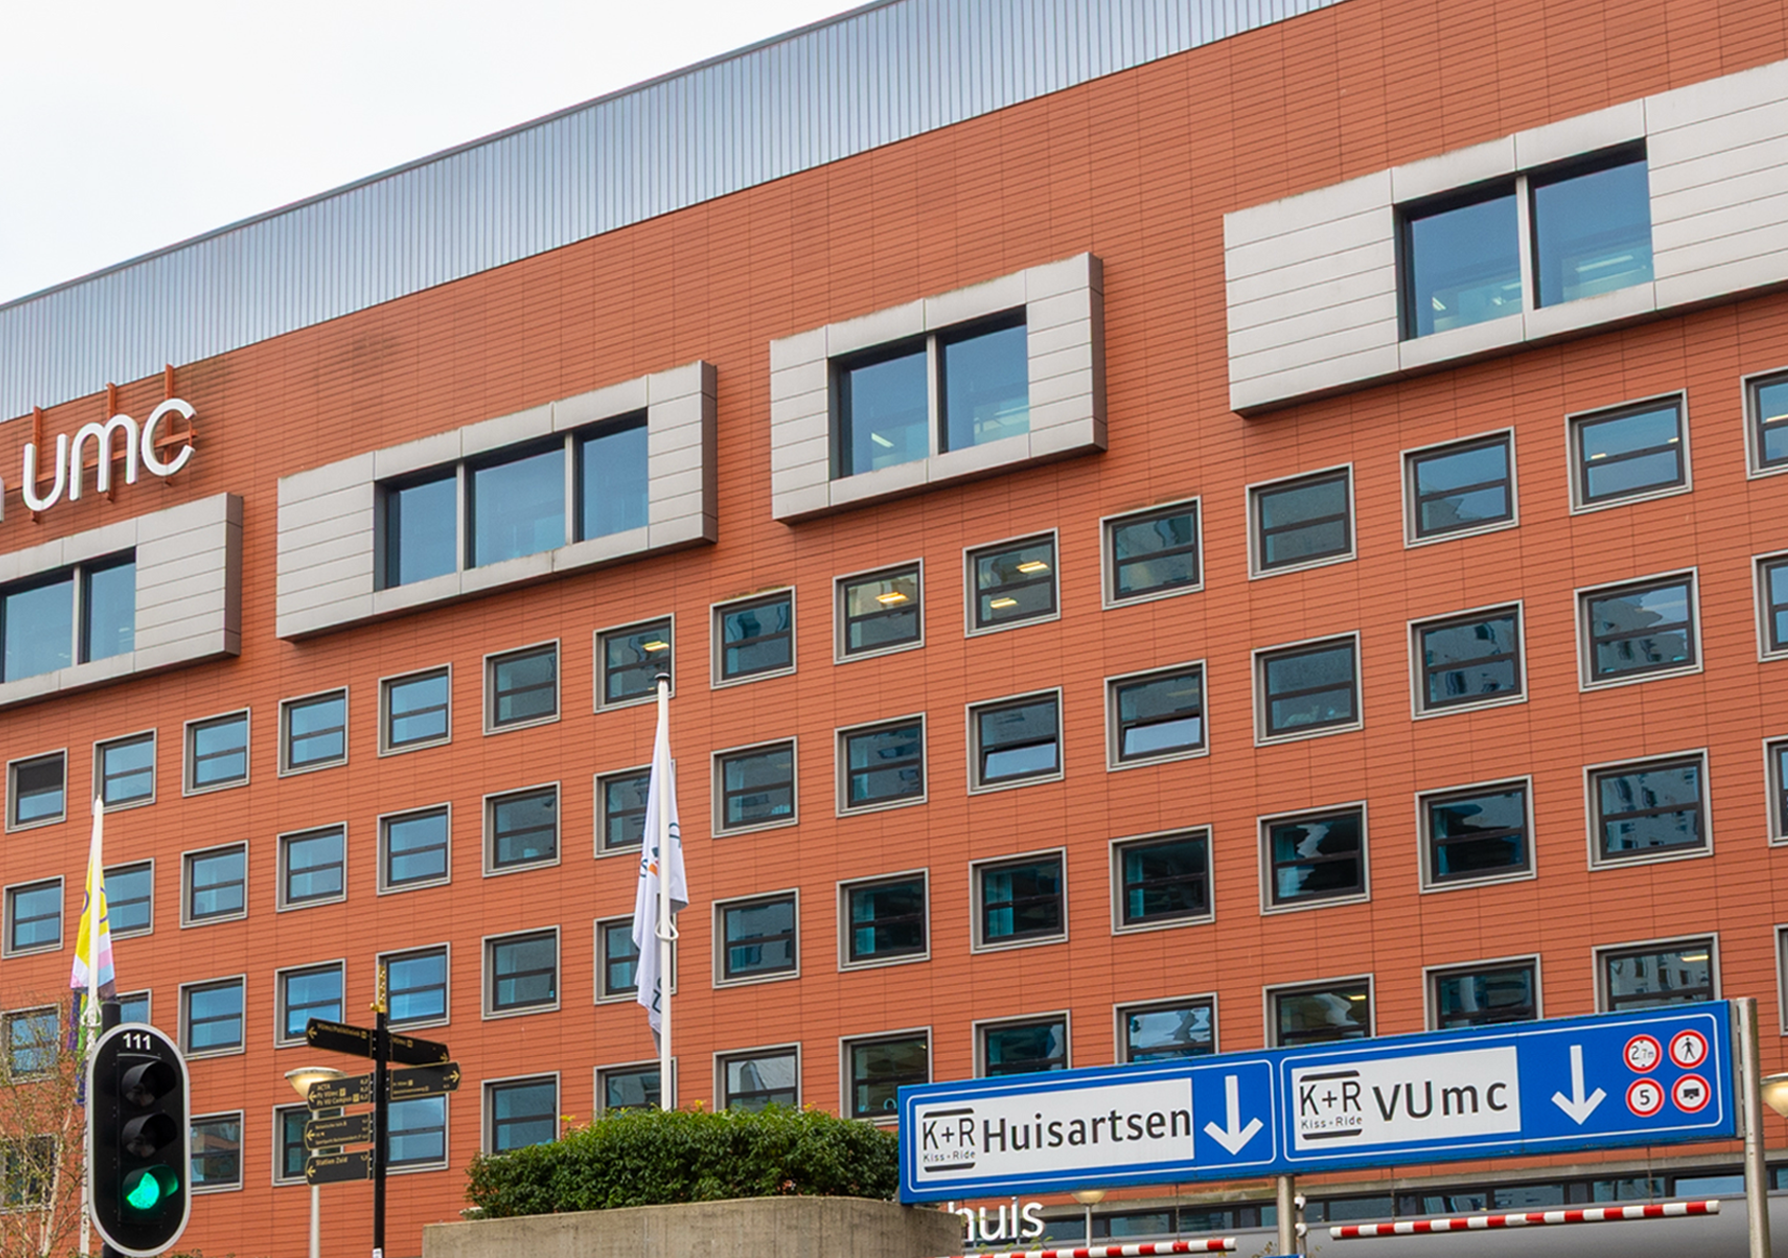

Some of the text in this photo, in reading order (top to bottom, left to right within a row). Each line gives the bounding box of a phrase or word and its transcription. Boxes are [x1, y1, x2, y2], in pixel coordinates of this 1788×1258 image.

[123, 1032, 150, 1049] 111
[1300, 1081, 1362, 1116] K+R
[1373, 1081, 1508, 1122] VUmc
[1640, 1089, 1650, 1105] 5
[922, 1117, 975, 1150] K+R
[983, 1108, 1191, 1153] Huisartsen
